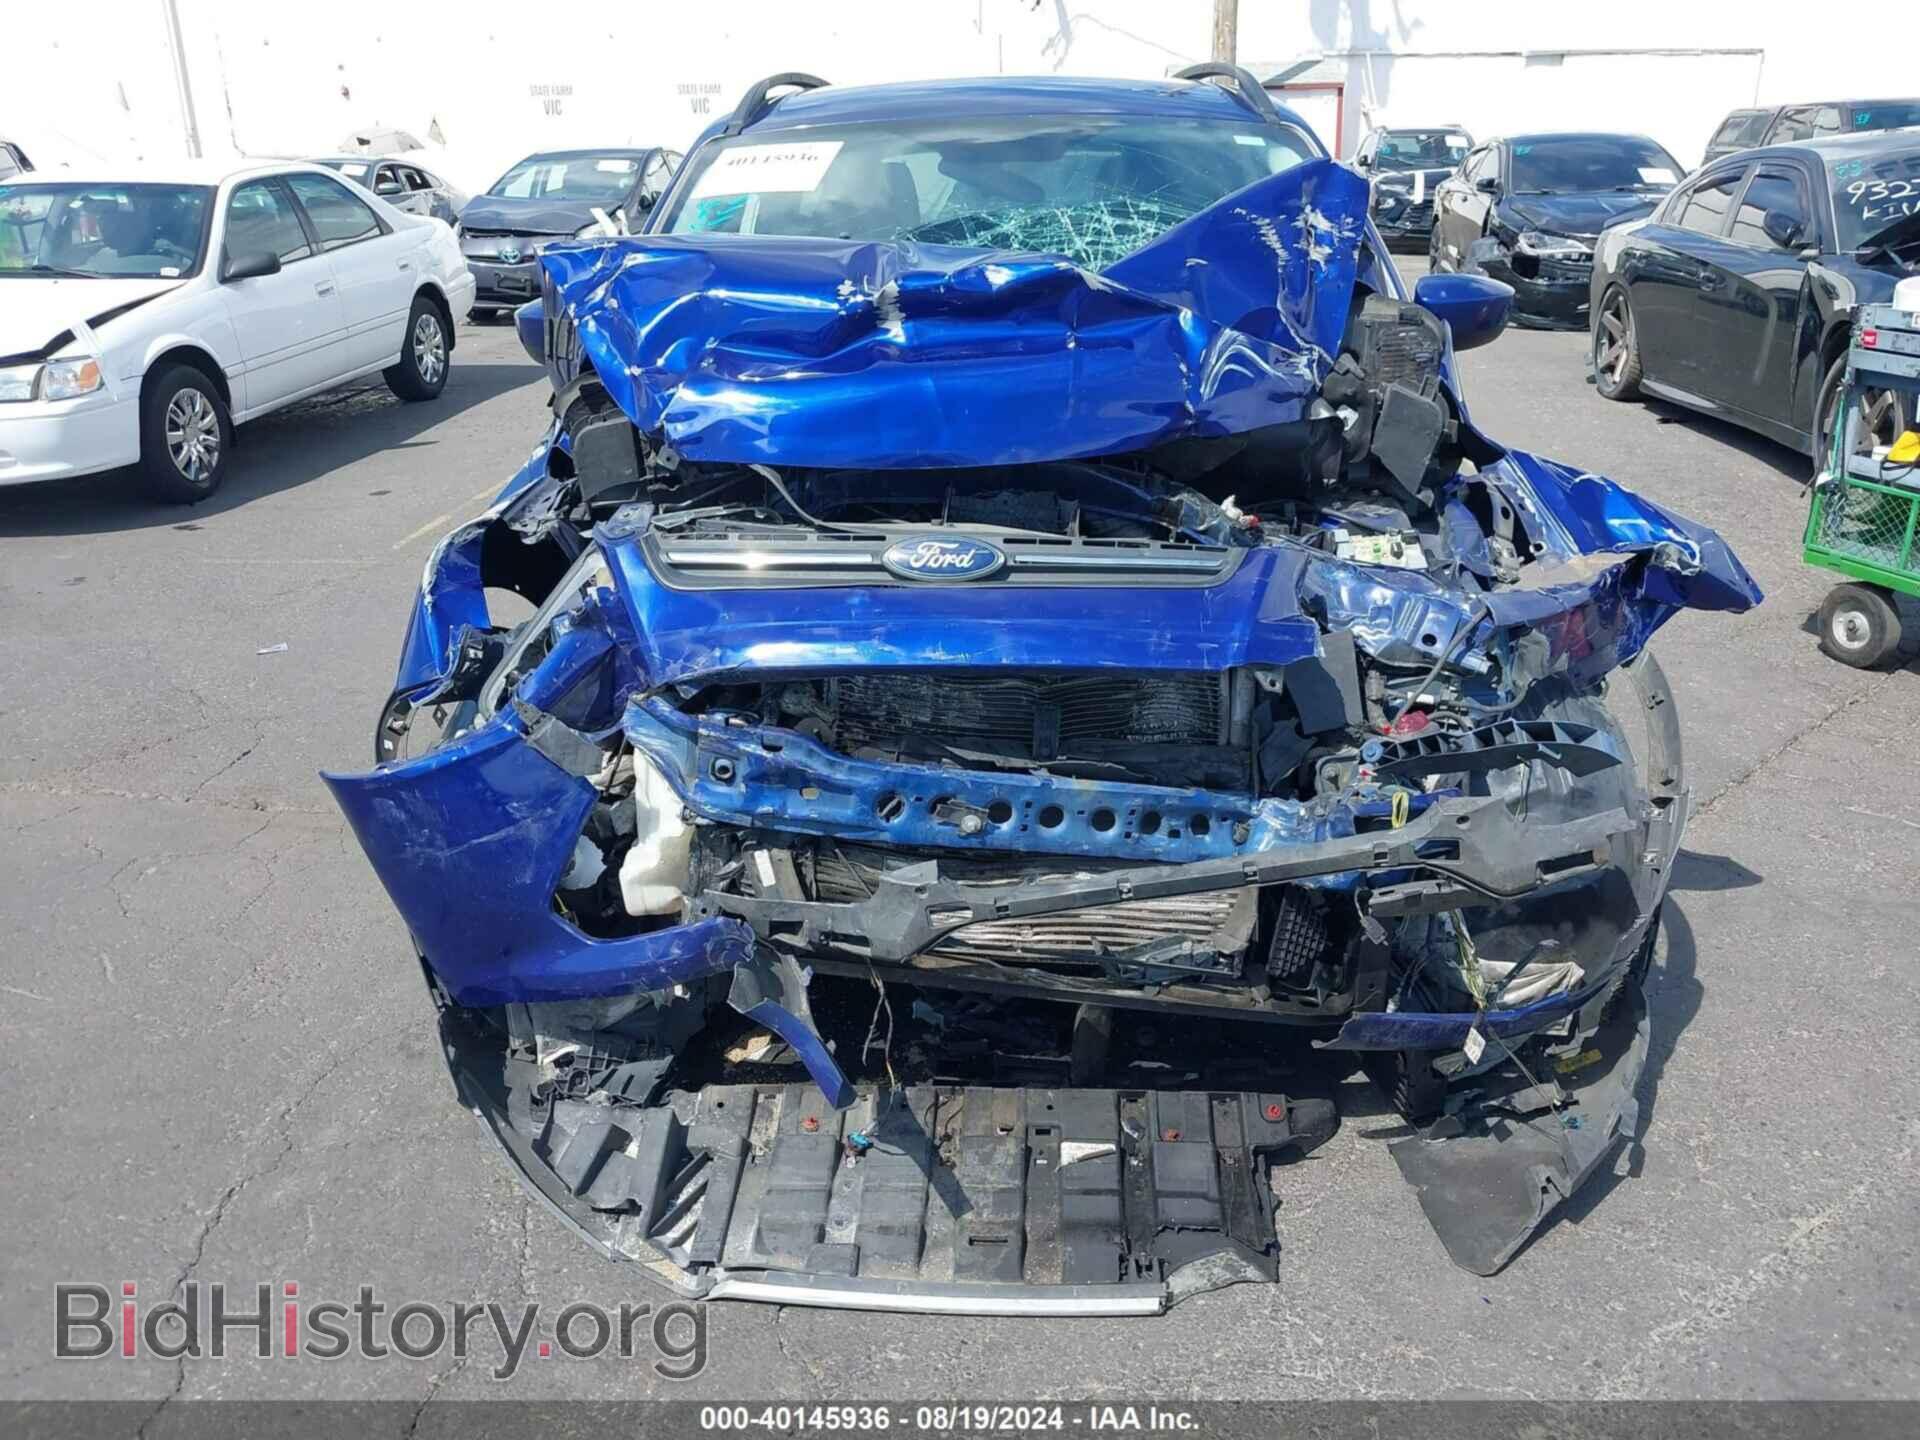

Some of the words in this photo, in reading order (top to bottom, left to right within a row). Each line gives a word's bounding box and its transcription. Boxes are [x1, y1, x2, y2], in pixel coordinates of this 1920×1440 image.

[543, 98, 562, 116] VIC
[690, 97, 710, 114] VIC
[1846, 178, 1920, 205] 932
[909, 541, 976, 569] Ford
